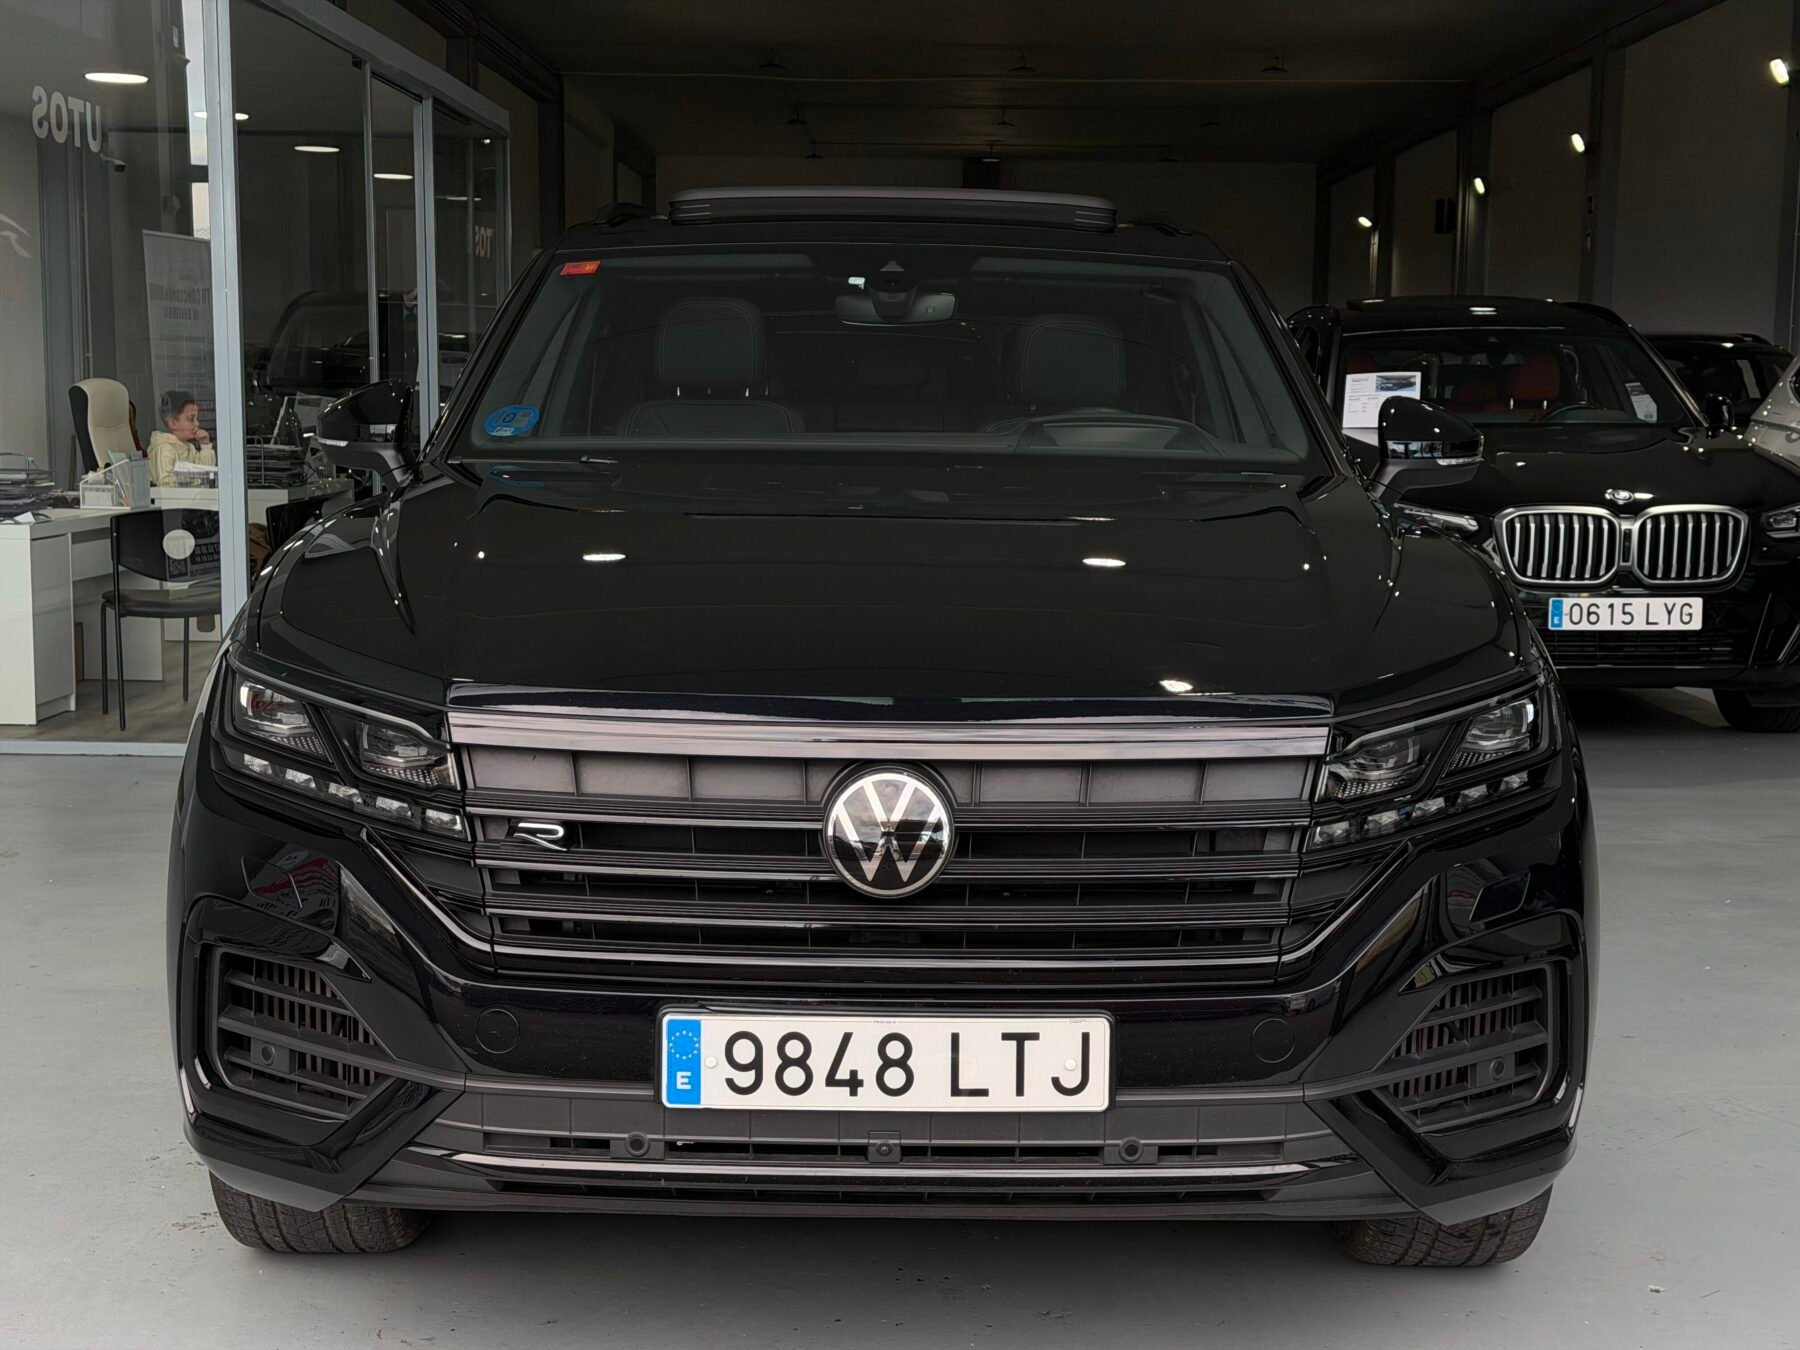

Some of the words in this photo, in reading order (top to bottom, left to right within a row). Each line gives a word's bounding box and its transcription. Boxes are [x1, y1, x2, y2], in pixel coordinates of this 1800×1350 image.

[1553, 616, 1560, 624] E
[1569, 602, 1635, 626] 0615
[1645, 602, 1693, 626] LYG
[724, 1030, 915, 1098] 9848
[950, 1031, 1091, 1098] LTJ
[676, 1071, 692, 1091] E
